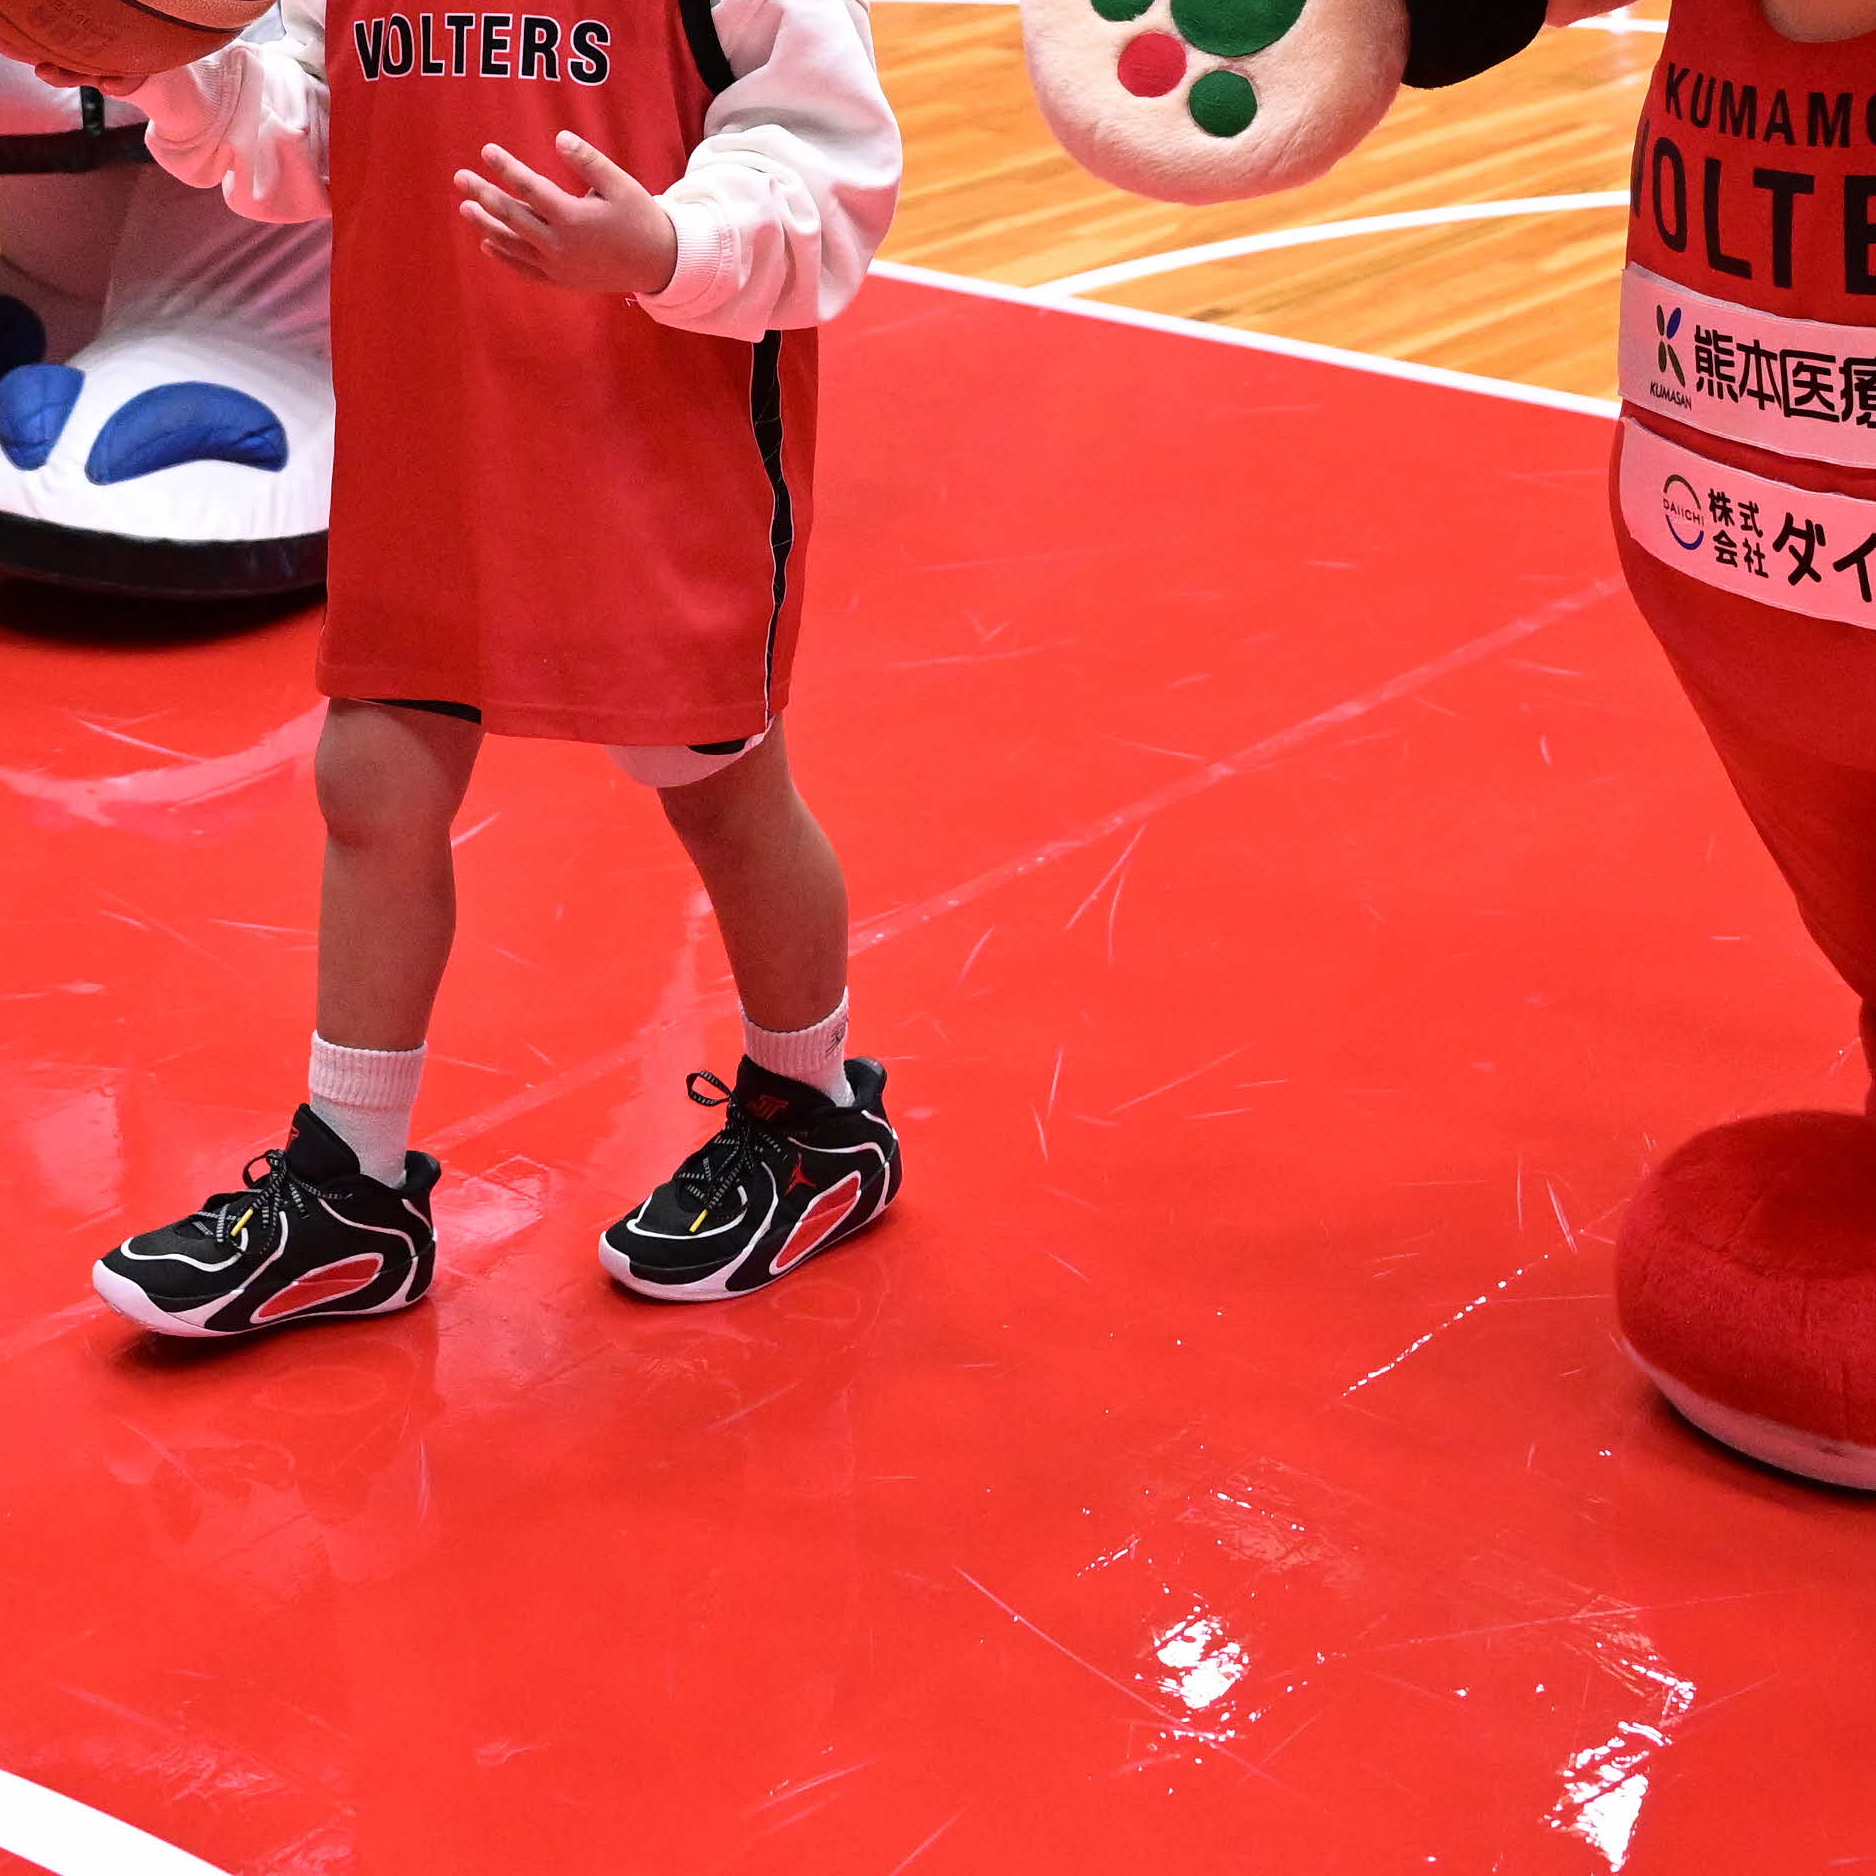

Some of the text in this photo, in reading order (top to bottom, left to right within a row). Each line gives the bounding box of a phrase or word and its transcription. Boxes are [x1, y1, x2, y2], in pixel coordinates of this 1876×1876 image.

[353, 12, 613, 86] VOLTERS
[1649, 381, 1692, 411] KUMASAN
[1663, 498, 1705, 527] DAIICHI
